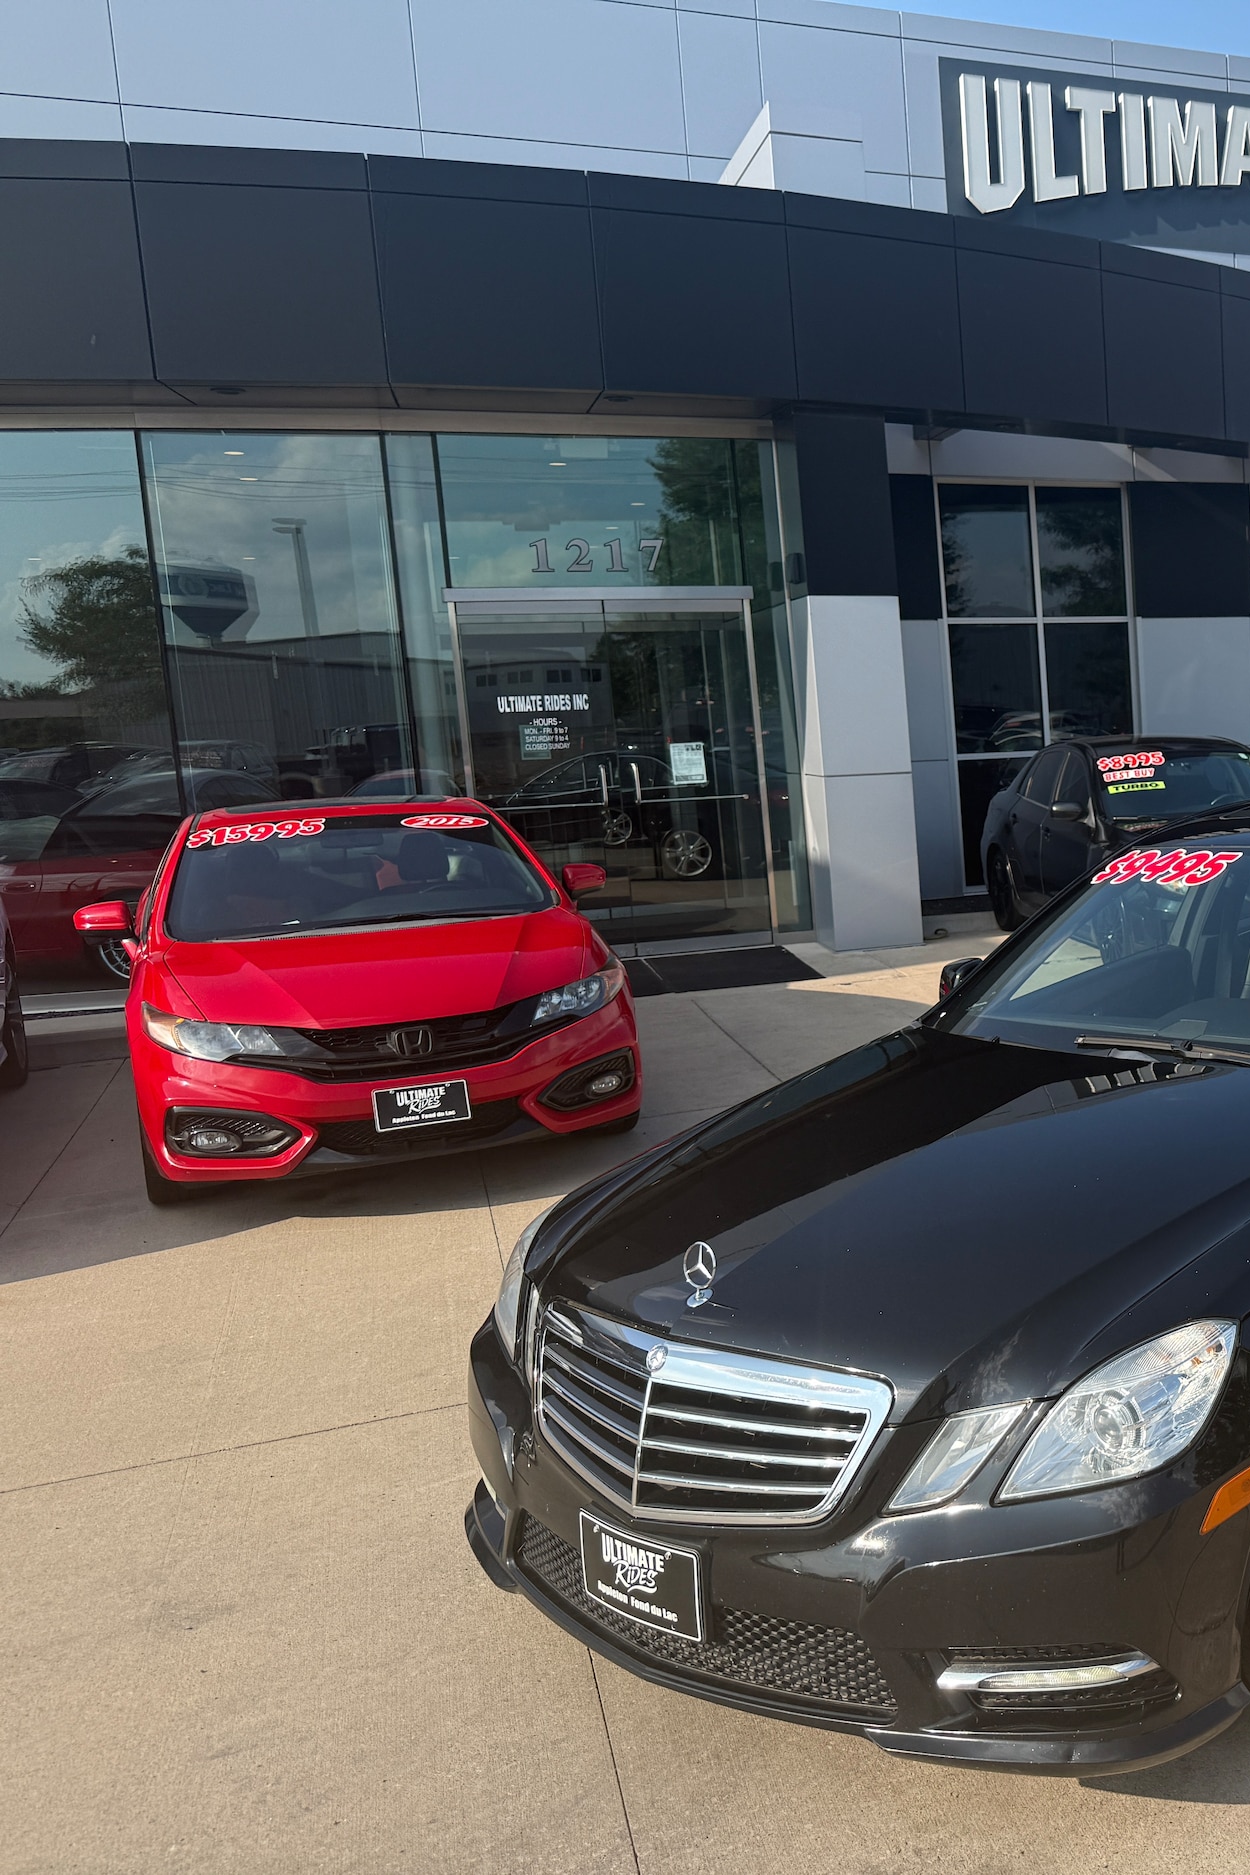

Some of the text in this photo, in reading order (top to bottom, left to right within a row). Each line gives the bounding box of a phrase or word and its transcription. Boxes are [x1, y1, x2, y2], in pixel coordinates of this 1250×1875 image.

[529, 538, 664, 573] 1217
[497, 693, 590, 713] ULTIMATE RIDES INC
[533, 718, 558, 726] HOURS
[525, 735, 554, 743] SATURDAY
[525, 742, 571, 751] CLOSED SUNDAY
[1097, 751, 1165, 771] $8995
[1104, 768, 1155, 781] BEST BUY
[1113, 782, 1160, 791] TURBO
[411, 816, 476, 826] 2015
[186, 818, 326, 849] $15995
[1090, 848, 1244, 887] $9495
[396, 1086, 447, 1107] ULTIMATE
[392, 1115, 420, 1124] Appleton
[421, 1112, 437, 1120] Fond
[601, 1532, 665, 1573] ULTIMATE
[597, 1580, 679, 1623] Appleton Fond du Lac
